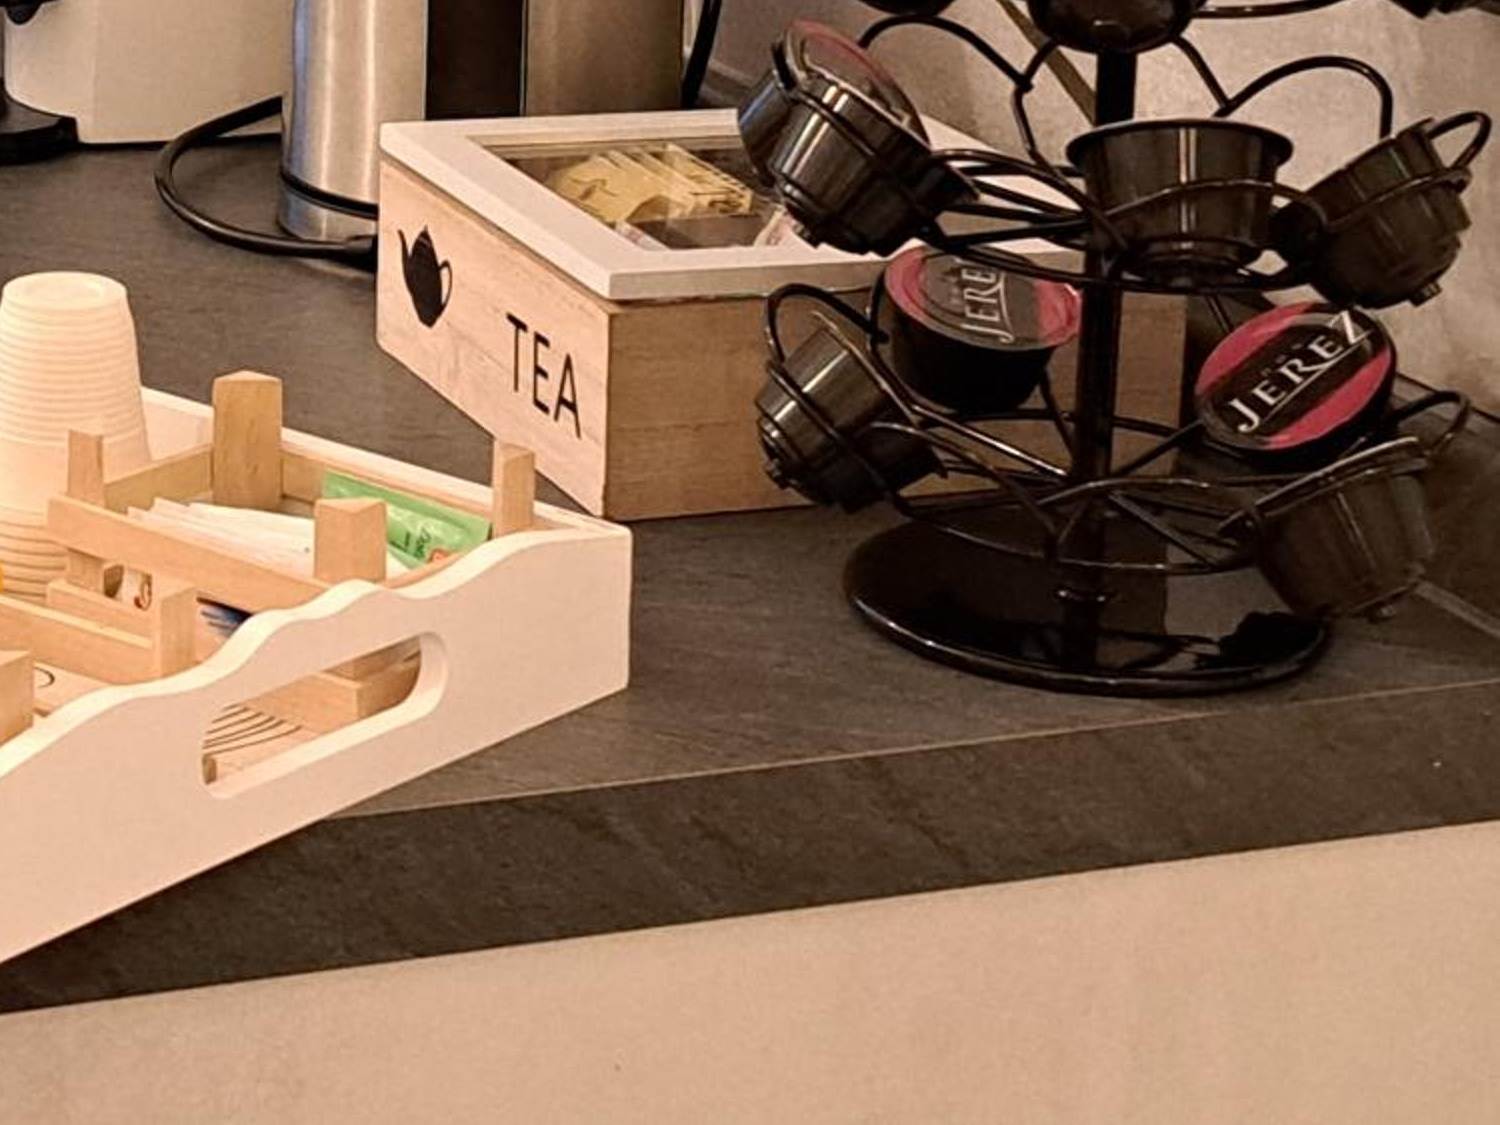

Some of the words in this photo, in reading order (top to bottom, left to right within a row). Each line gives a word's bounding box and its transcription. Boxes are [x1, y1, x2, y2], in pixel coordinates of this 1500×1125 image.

[960, 255, 1015, 344] JERE
[506, 312, 582, 439] TEA
[1229, 310, 1372, 433] JEREZ
